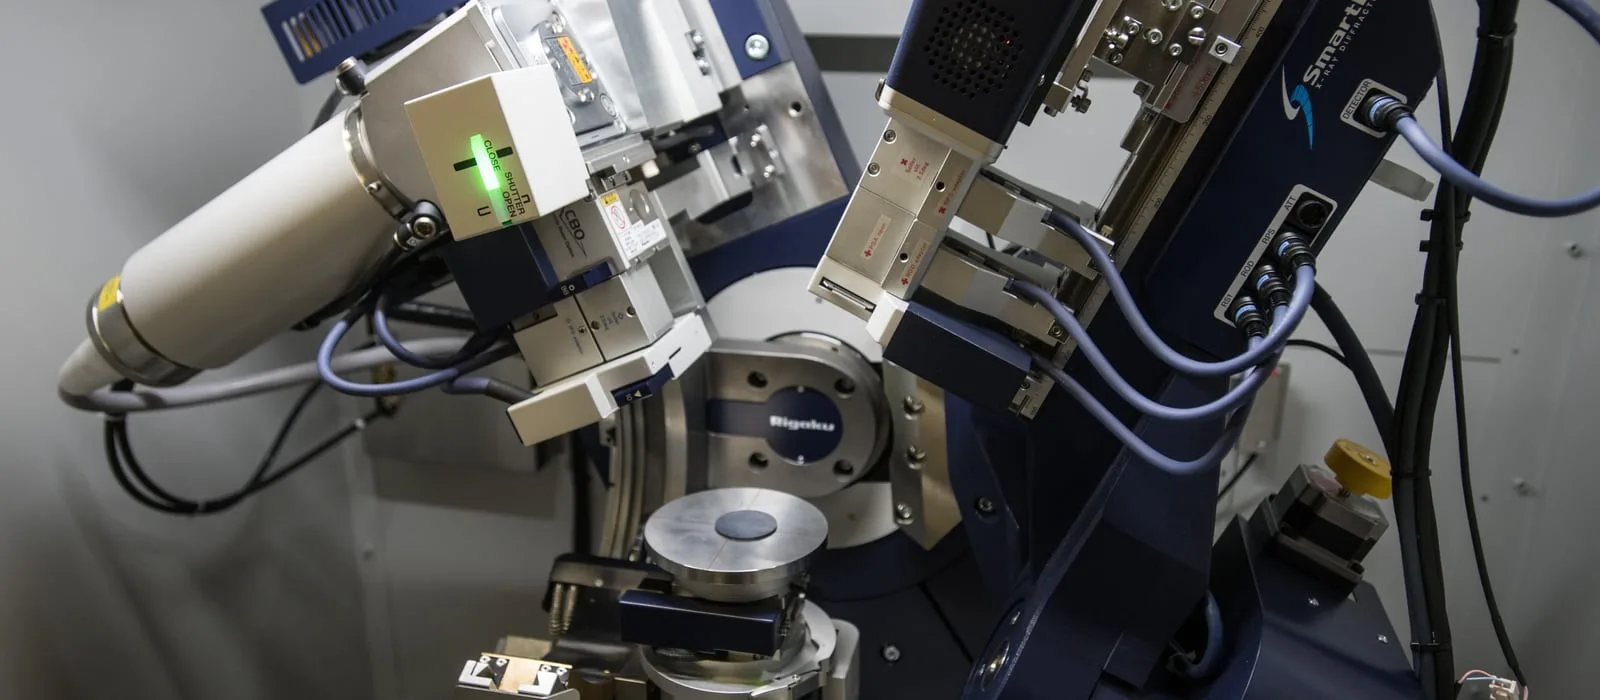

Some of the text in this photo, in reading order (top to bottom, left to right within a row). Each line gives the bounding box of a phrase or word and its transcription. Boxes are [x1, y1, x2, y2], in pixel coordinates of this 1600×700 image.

[1316, 0, 1376, 89] X-RAY DIFFRACT
[1343, 80, 1371, 119] DETECTOR
[483, 139, 500, 171] CLOSE
[502, 191, 517, 218] OPEN
[504, 171, 525, 215] SHUTTER
[1284, 196, 1298, 211] ATT
[564, 209, 585, 241] CBO
[1262, 228, 1275, 245] RPS
[1241, 260, 1254, 277] ROD
[769, 415, 835, 432] Rigaku
